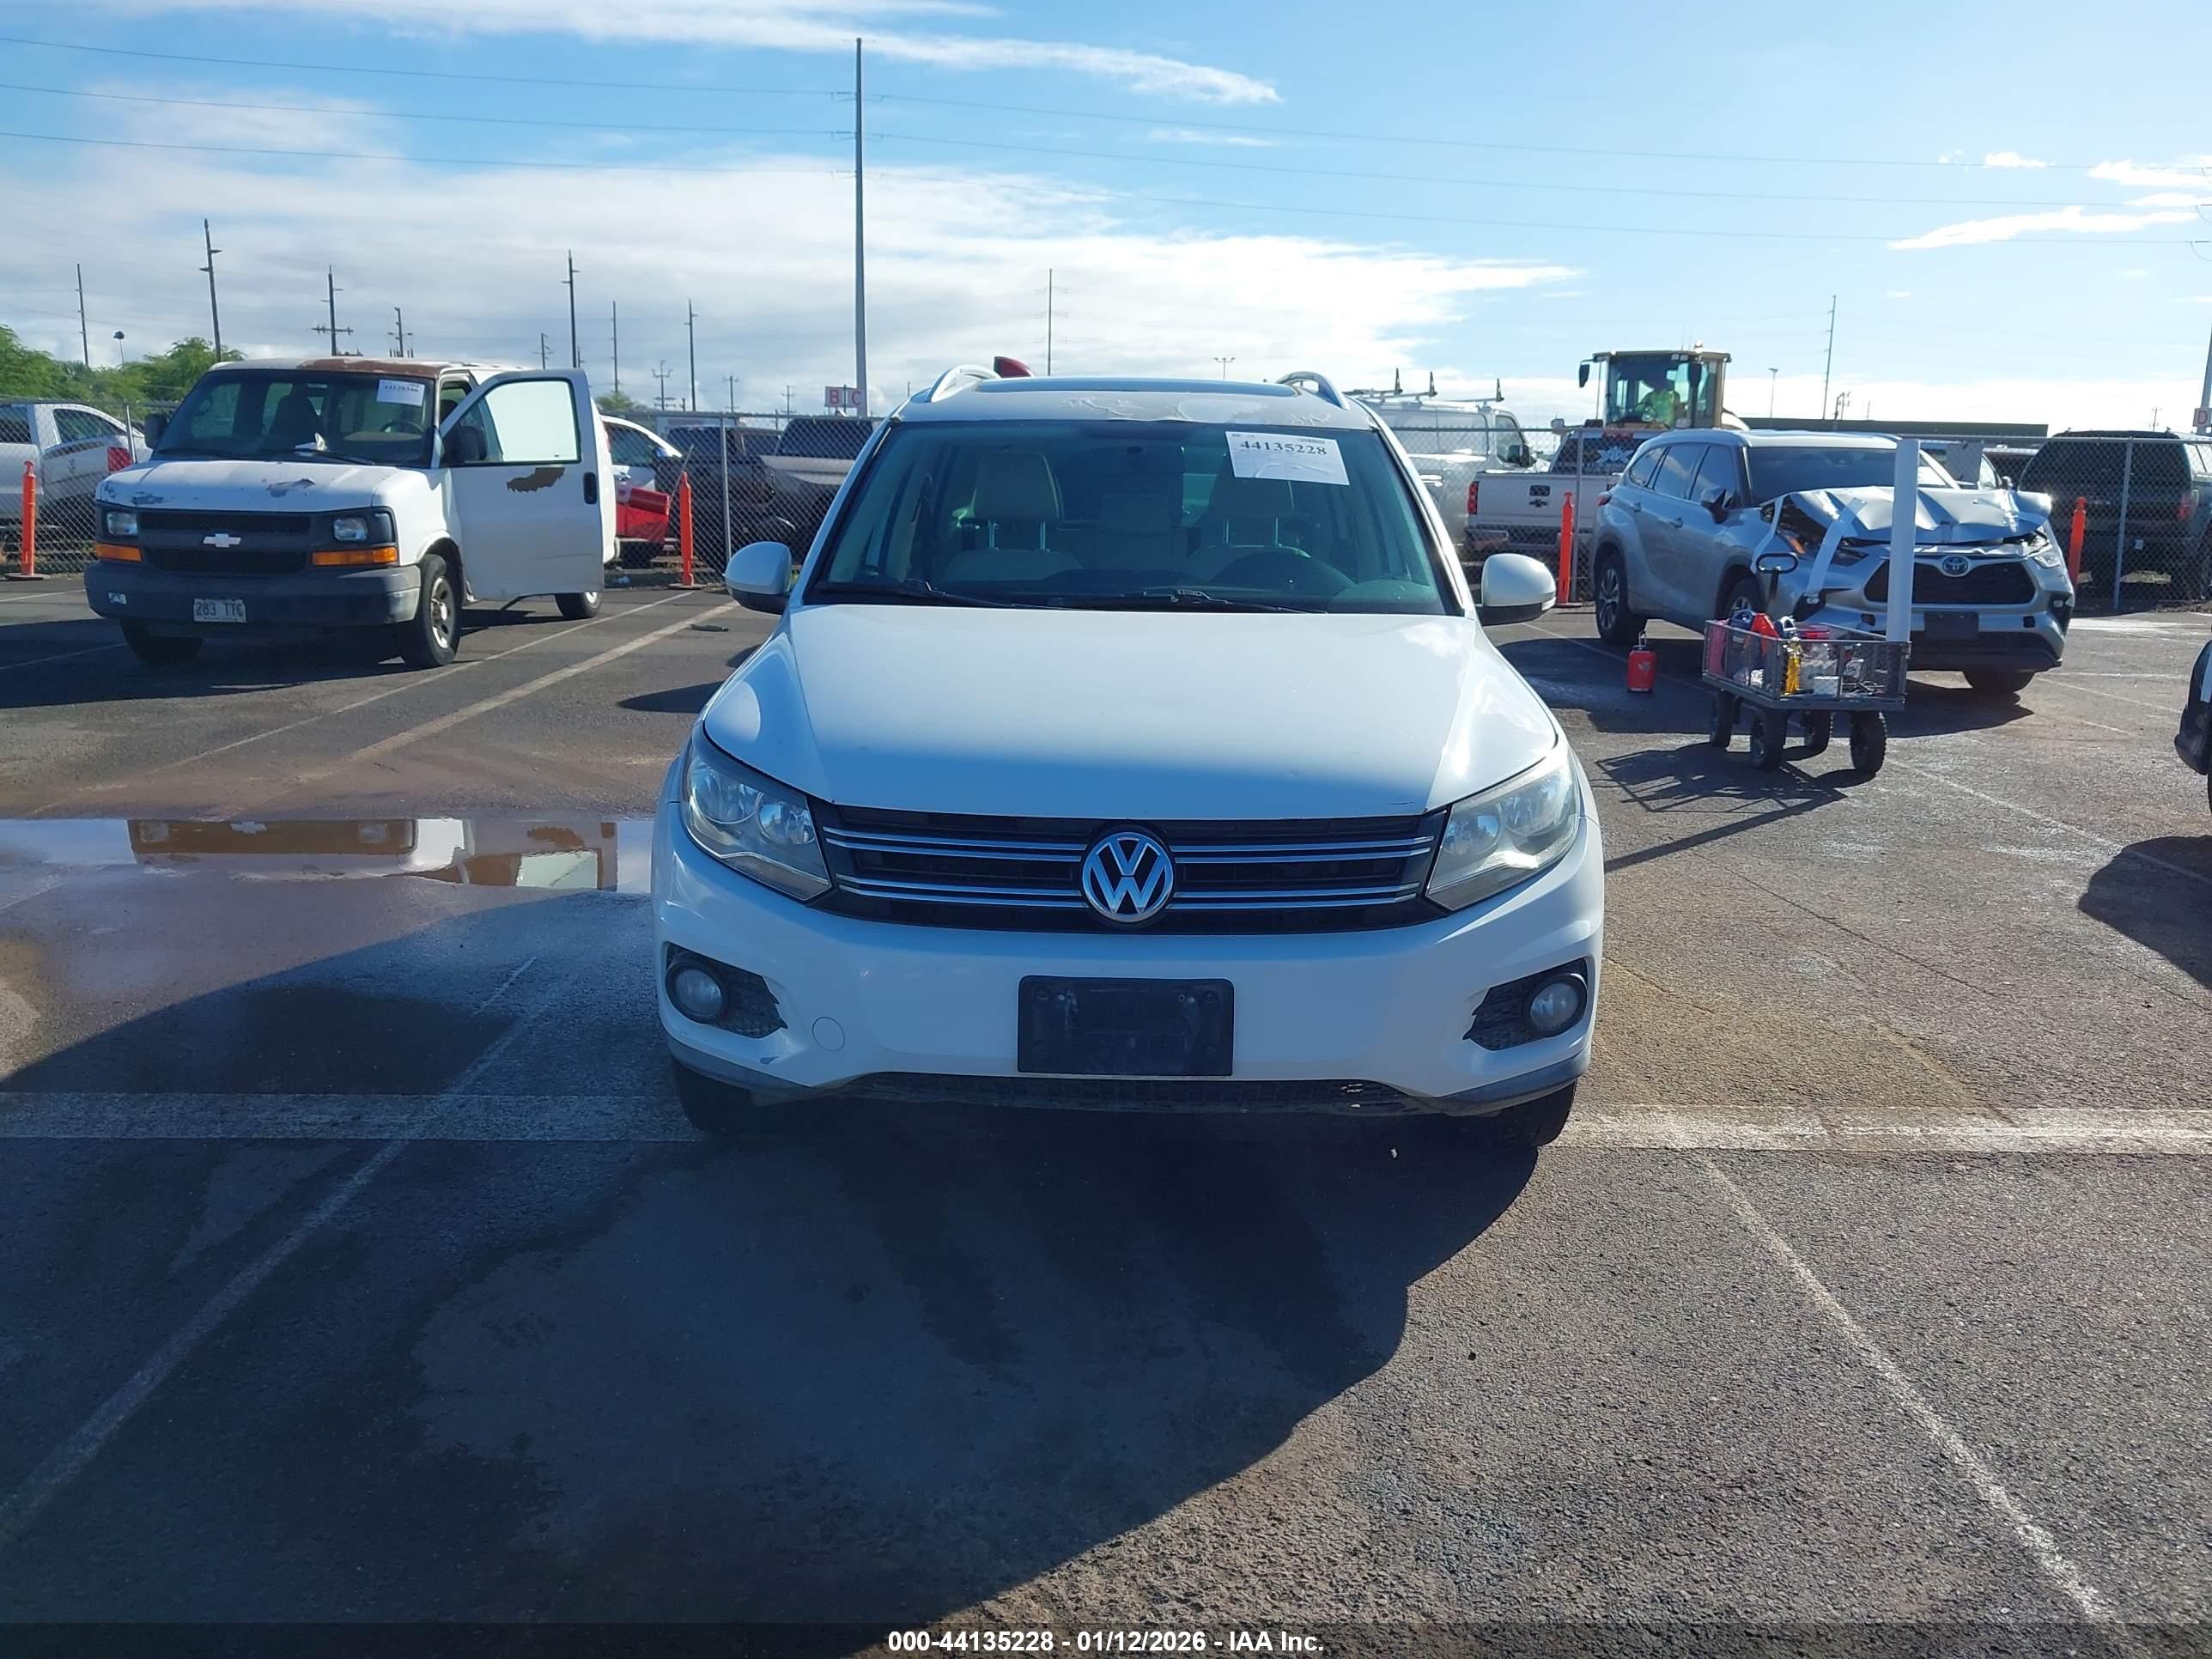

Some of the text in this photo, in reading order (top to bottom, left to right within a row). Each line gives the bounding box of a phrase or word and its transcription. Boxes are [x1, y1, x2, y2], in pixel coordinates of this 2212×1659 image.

[830, 389, 839, 404] B
[852, 391, 862, 405] C
[2198, 410, 2208, 424] D
[1240, 441, 1327, 455] 44135228
